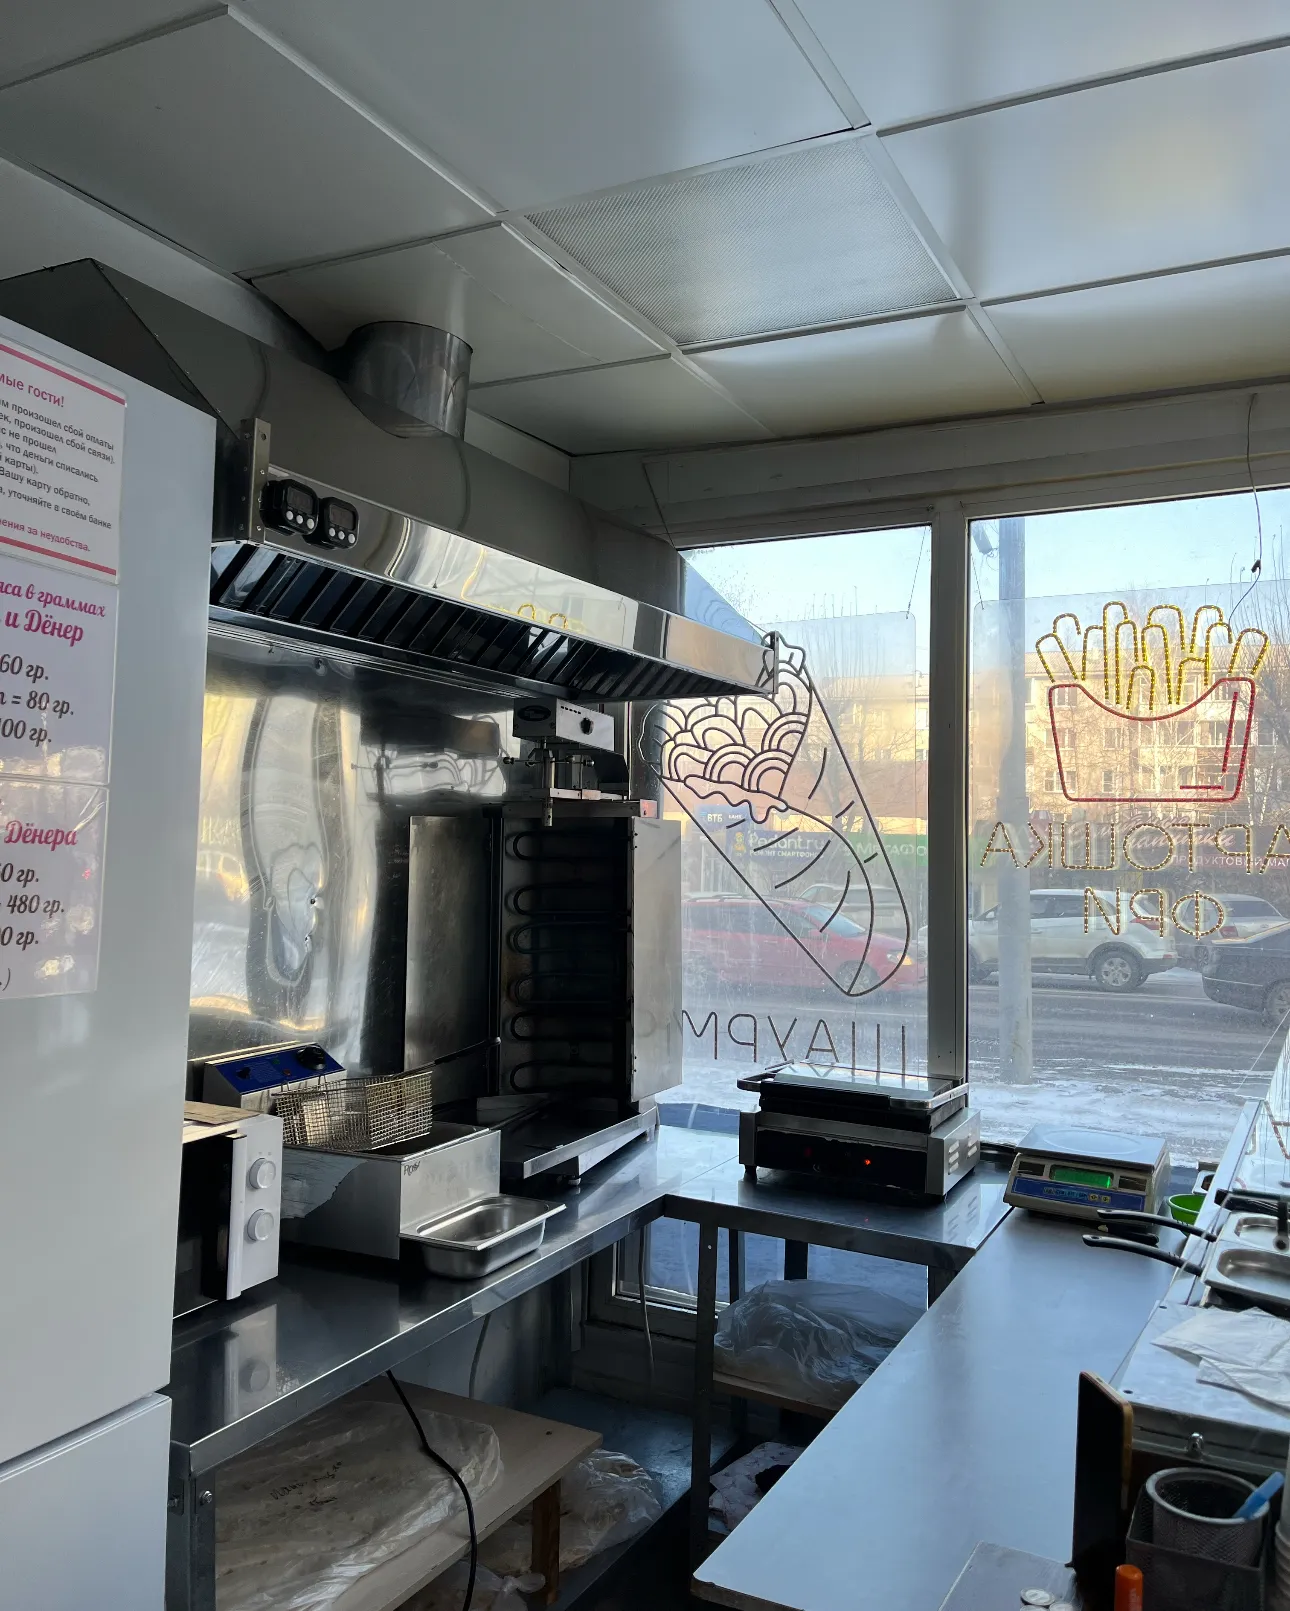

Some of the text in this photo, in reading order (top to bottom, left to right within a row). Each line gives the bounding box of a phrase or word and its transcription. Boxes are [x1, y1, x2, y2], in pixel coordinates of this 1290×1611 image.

[28, 385, 65, 408] гости!
[12, 403, 61, 430] произошел
[64, 424, 84, 438] сбой
[86, 433, 114, 451] оплаты
[14, 418, 64, 444] произошел
[66, 438, 86, 453] сбой
[9, 430, 20, 440] не
[22, 436, 57, 454] прошел
[5, 456, 39, 475] карты).
[6, 442, 21, 454] что
[23, 449, 54, 466] деньги
[55, 462, 99, 483] списались
[26, 477, 51, 494] карту
[54, 487, 90, 506] обратно,
[8, 488, 52, 509] уточняйте
[54, 504, 59, 512] в
[61, 507, 87, 522] своём
[88, 514, 112, 530] банке
[0, 518, 90, 552] ения за неудобства.
[25, 583, 35, 600] в
[37, 590, 105, 618] граммах
[5, 608, 84, 647] и Дёнер
[26, 664, 49, 684] гр.
[26, 690, 50, 711] 80
[52, 699, 74, 719] гр.
[0, 717, 52, 747] 00 гр.
[707, 813, 723, 823] ВТБ
[4, 819, 78, 851] Дёнера
[777, 850, 826, 860] СМАРТФОН
[1172, 855, 1265, 868] ПРДУКТОВЙ
[16, 868, 39, 889] гр.
[7, 894, 65, 919] 480 гр.
[16, 930, 39, 951] гр.
